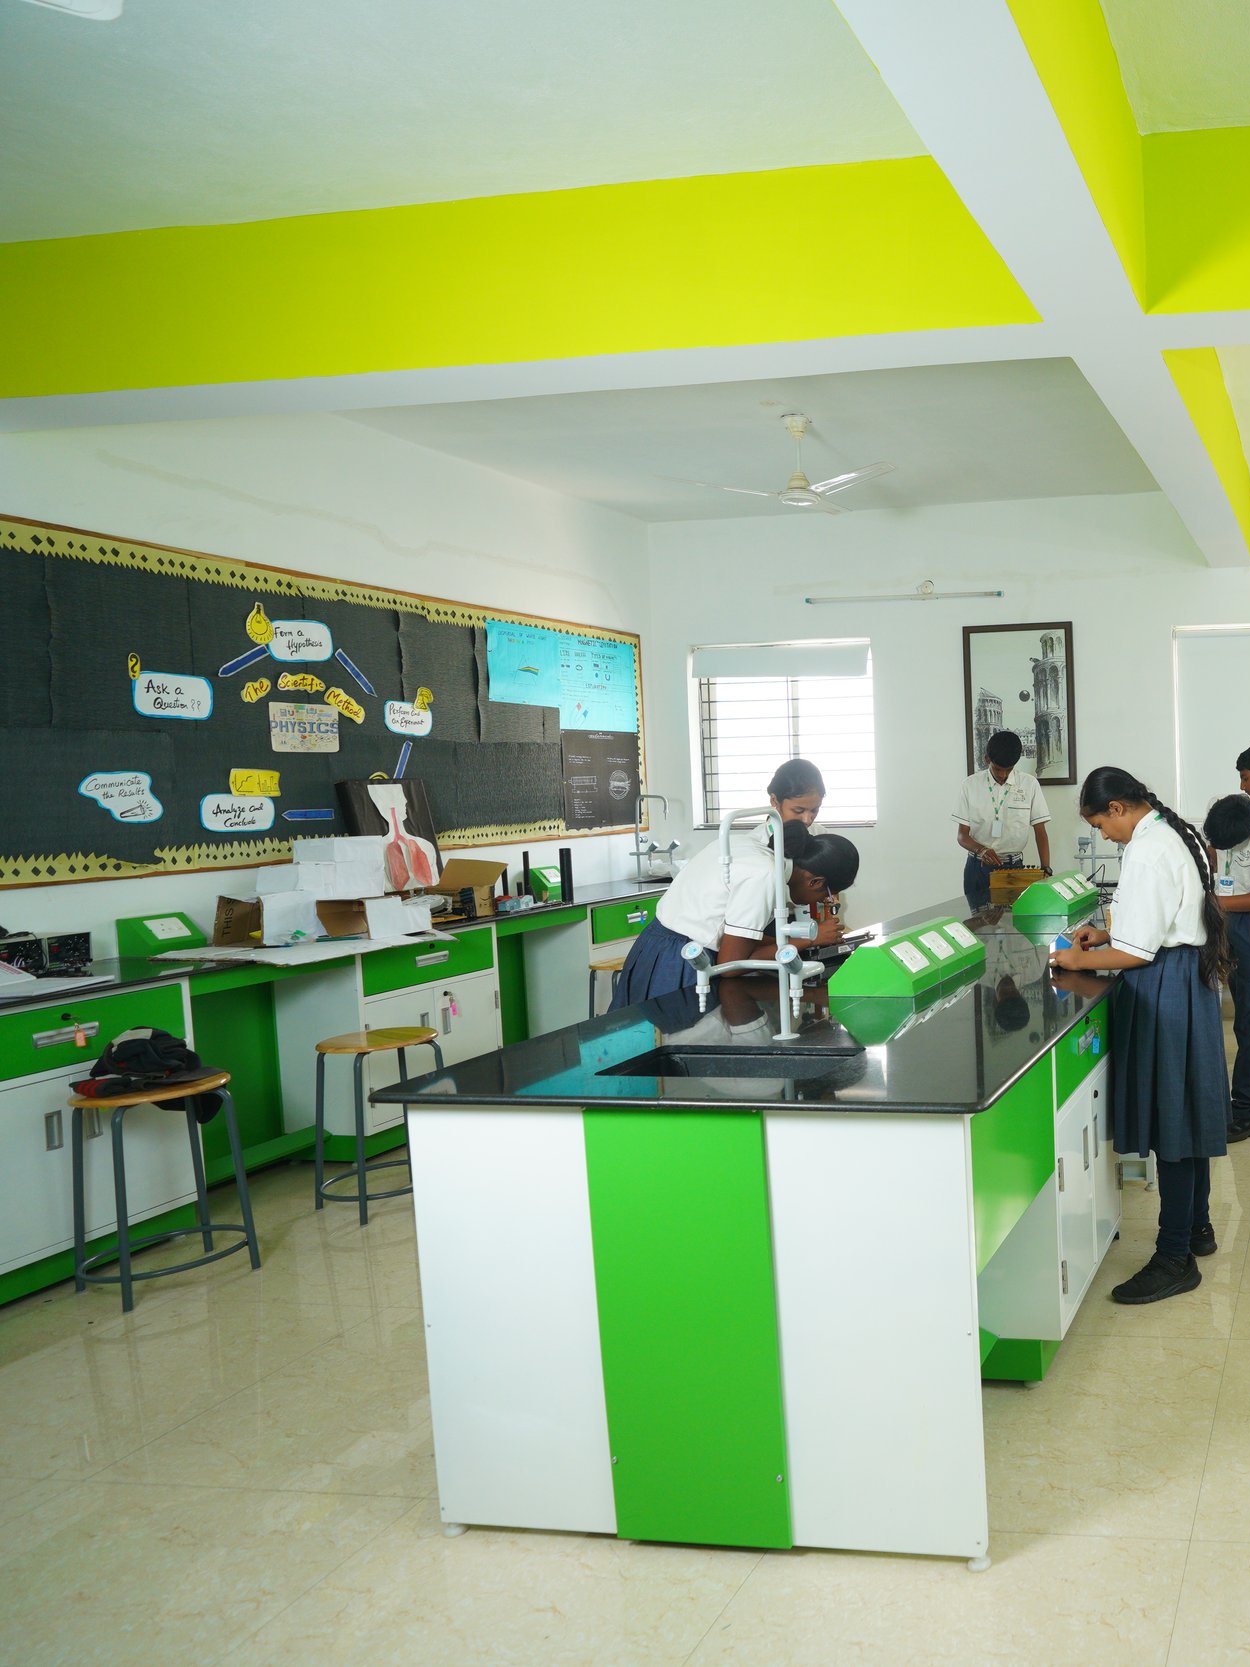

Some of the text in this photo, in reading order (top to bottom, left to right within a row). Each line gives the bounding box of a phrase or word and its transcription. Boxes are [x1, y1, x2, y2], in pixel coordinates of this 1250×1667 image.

[296, 629, 304, 637] a
[286, 638, 323, 656] Hypothesis
[144, 679, 184, 695] Ask a
[244, 674, 361, 719] The Scientific Method
[270, 720, 339, 735] PHYSICS
[86, 775, 142, 792] Communicate
[102, 787, 145, 800] the Results
[212, 803, 246, 819] Analyze
[222, 908, 234, 936] THIS
